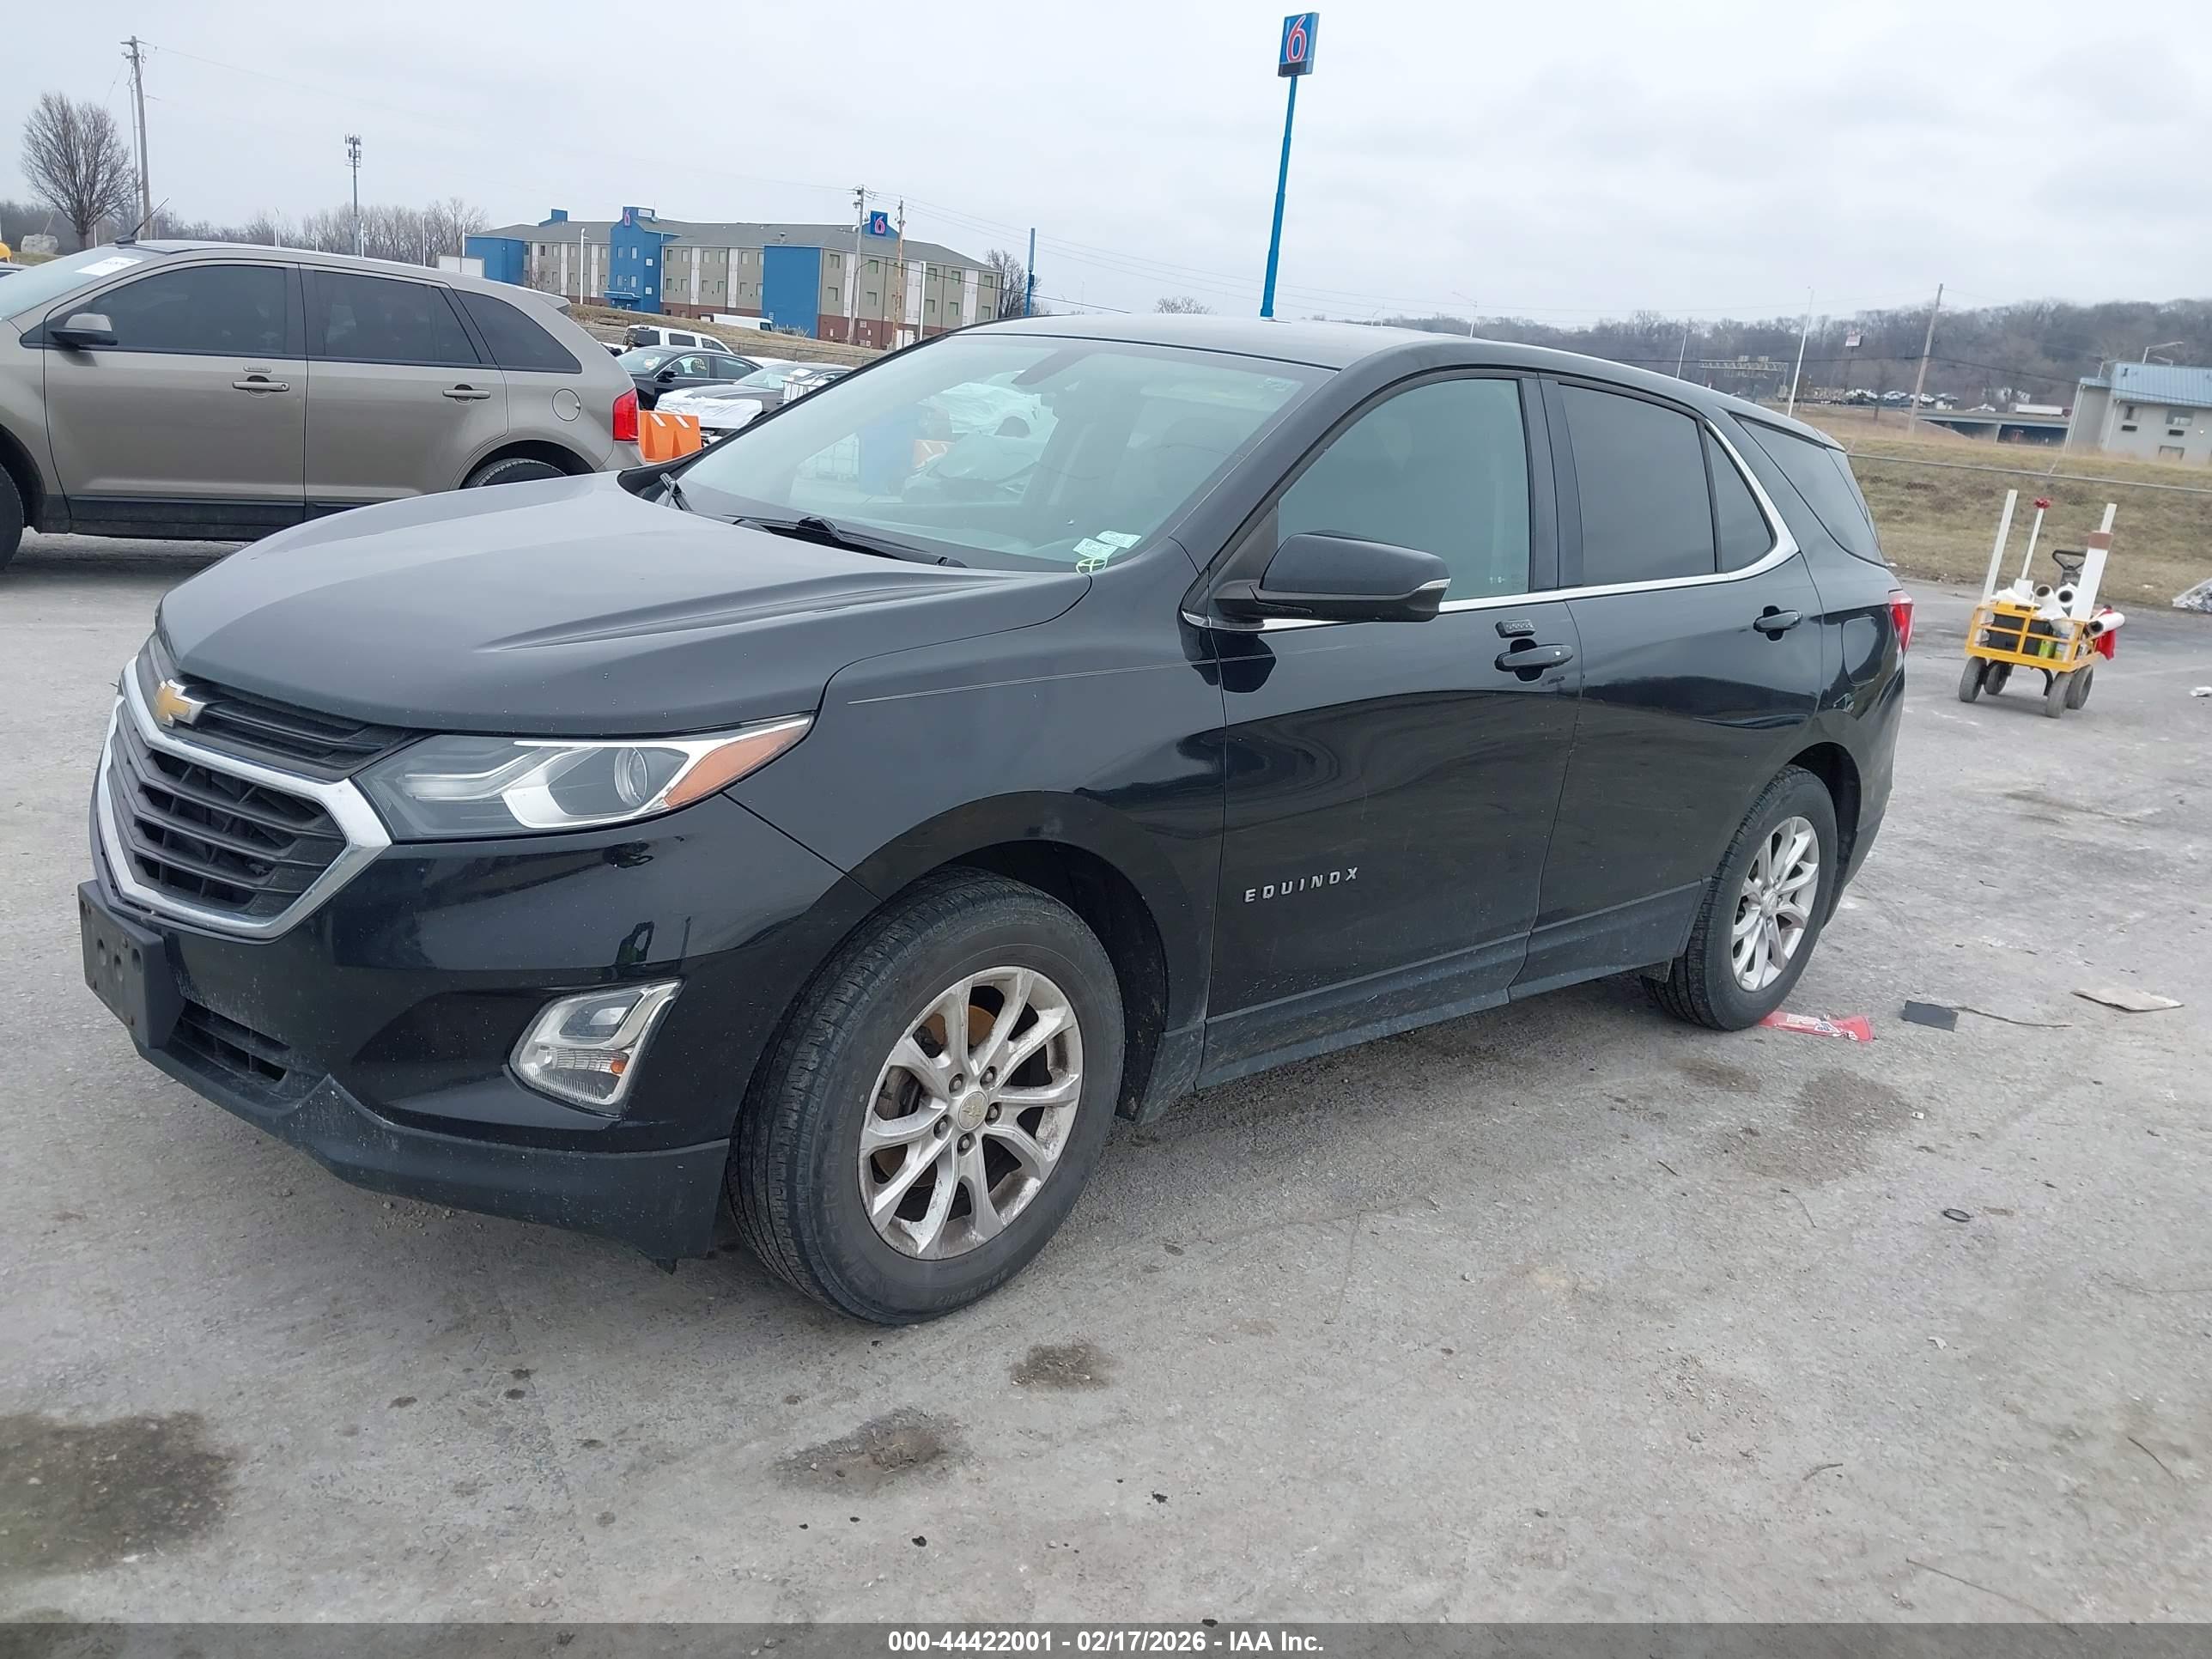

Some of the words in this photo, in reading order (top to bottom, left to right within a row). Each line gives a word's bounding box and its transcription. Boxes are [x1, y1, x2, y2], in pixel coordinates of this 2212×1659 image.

[1286, 15, 1307, 63] 6
[624, 210, 631, 227] 6
[874, 216, 885, 234] 6
[1244, 866, 1358, 902] EQUINOX
